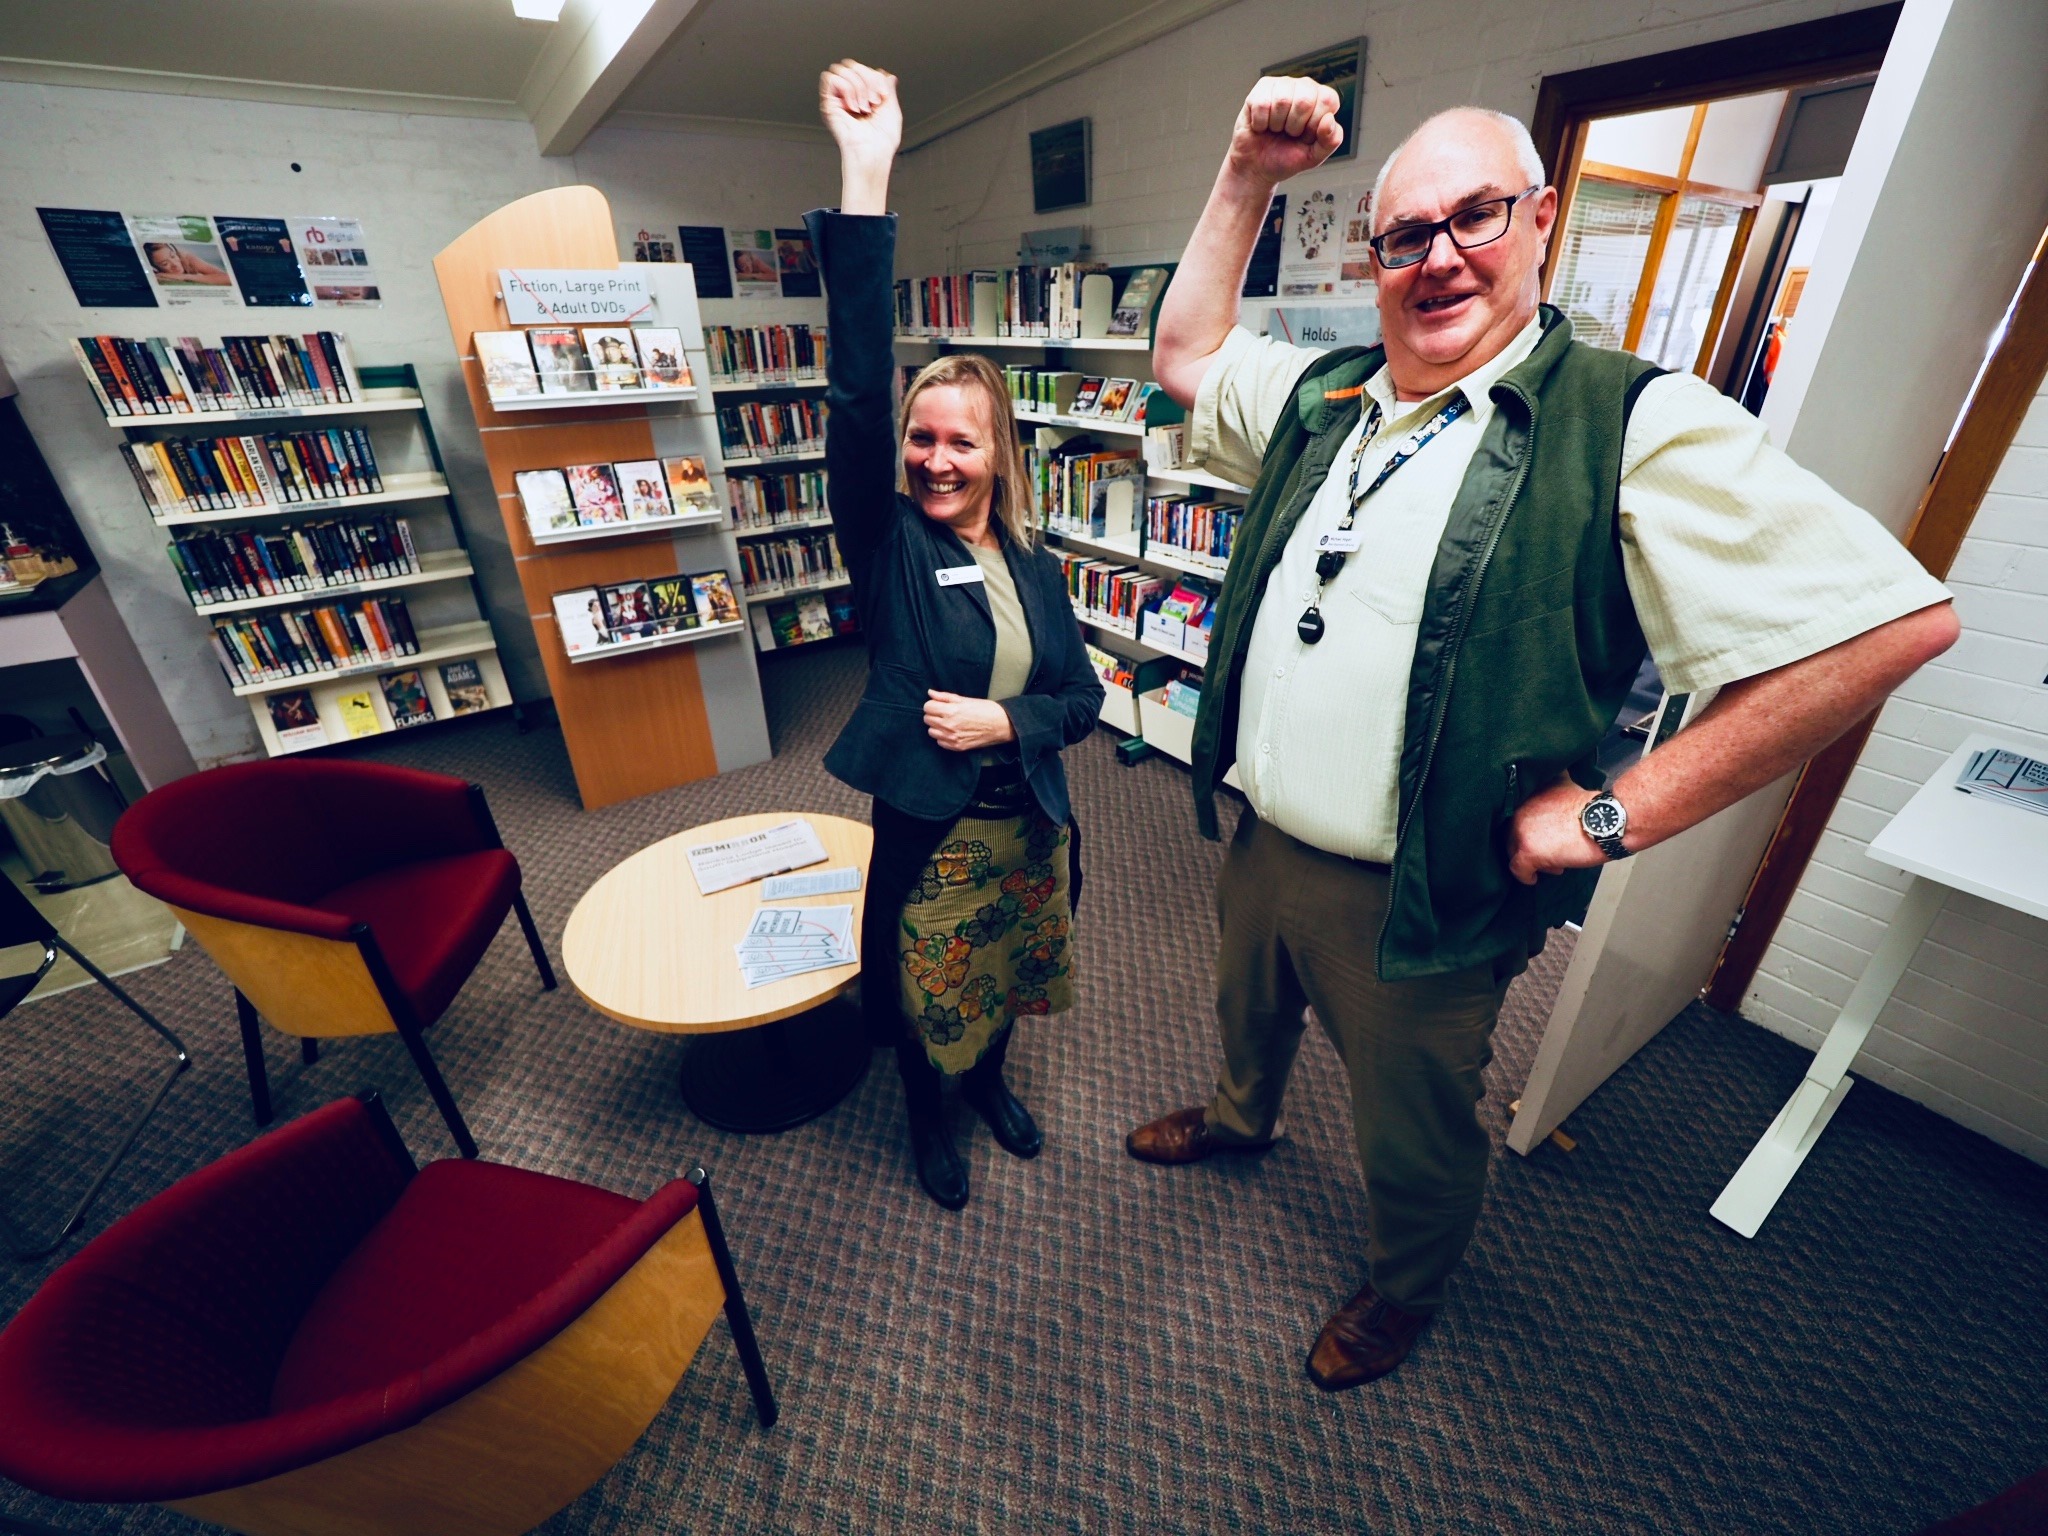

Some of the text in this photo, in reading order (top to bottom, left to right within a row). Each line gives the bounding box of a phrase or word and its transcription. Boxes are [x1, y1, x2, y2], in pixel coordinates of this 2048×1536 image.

[305, 226, 326, 244] rb
[637, 229, 651, 241] rb
[509, 279, 641, 296] Fiction, Large Print
[537, 302, 626, 315] & Adult DVDs
[1302, 327, 1337, 342] Holds
[243, 438, 269, 487] HARLAN COBEN
[447, 670, 476, 683] ADAMS
[395, 711, 434, 728] FLAMES
[715, 833, 767, 852] MIRROR
